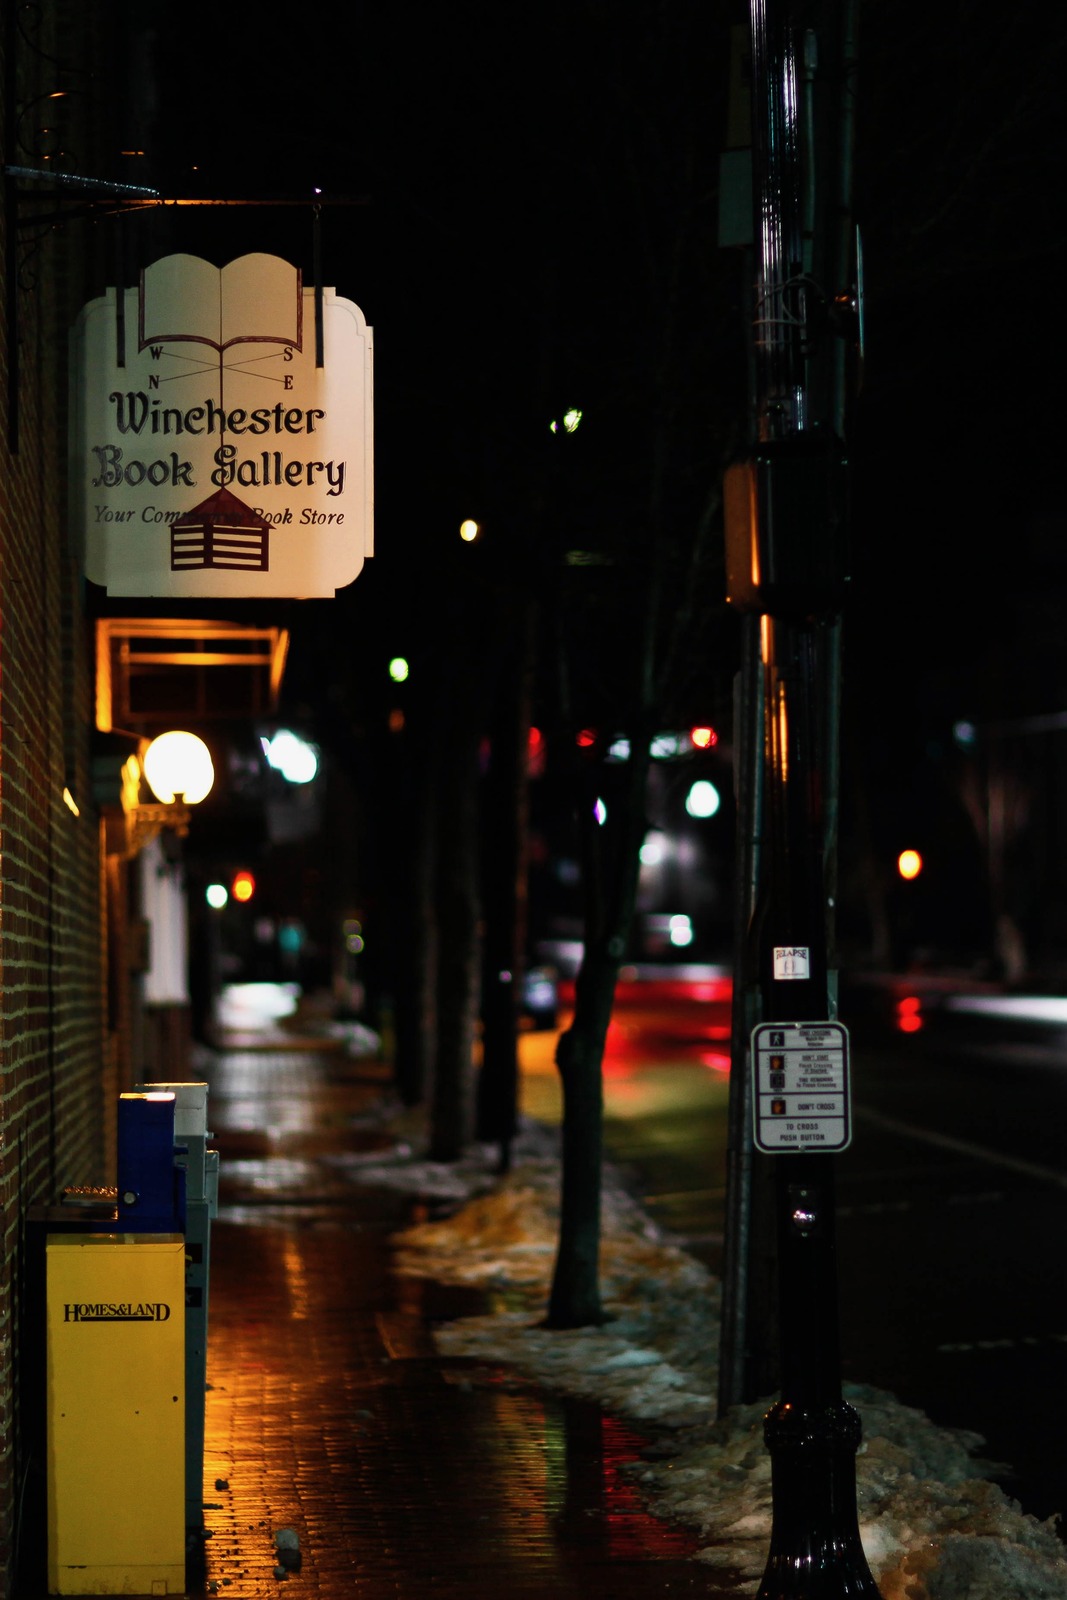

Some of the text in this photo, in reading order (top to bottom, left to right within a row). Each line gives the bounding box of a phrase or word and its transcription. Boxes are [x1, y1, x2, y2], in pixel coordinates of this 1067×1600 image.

[150, 347, 163, 360] W
[284, 347, 294, 362] S
[148, 375, 160, 390] N
[284, 375, 294, 390] E
[109, 391, 326, 436] Winchester
[92, 444, 347, 497] Book Gallery
[94, 505, 135, 524] Your
[299, 508, 346, 526] Store
[797, 1103, 815, 1111] DON'T
[785, 1123, 819, 1131] TO CROSS
[780, 1133, 825, 1142] PUSH BUTTON
